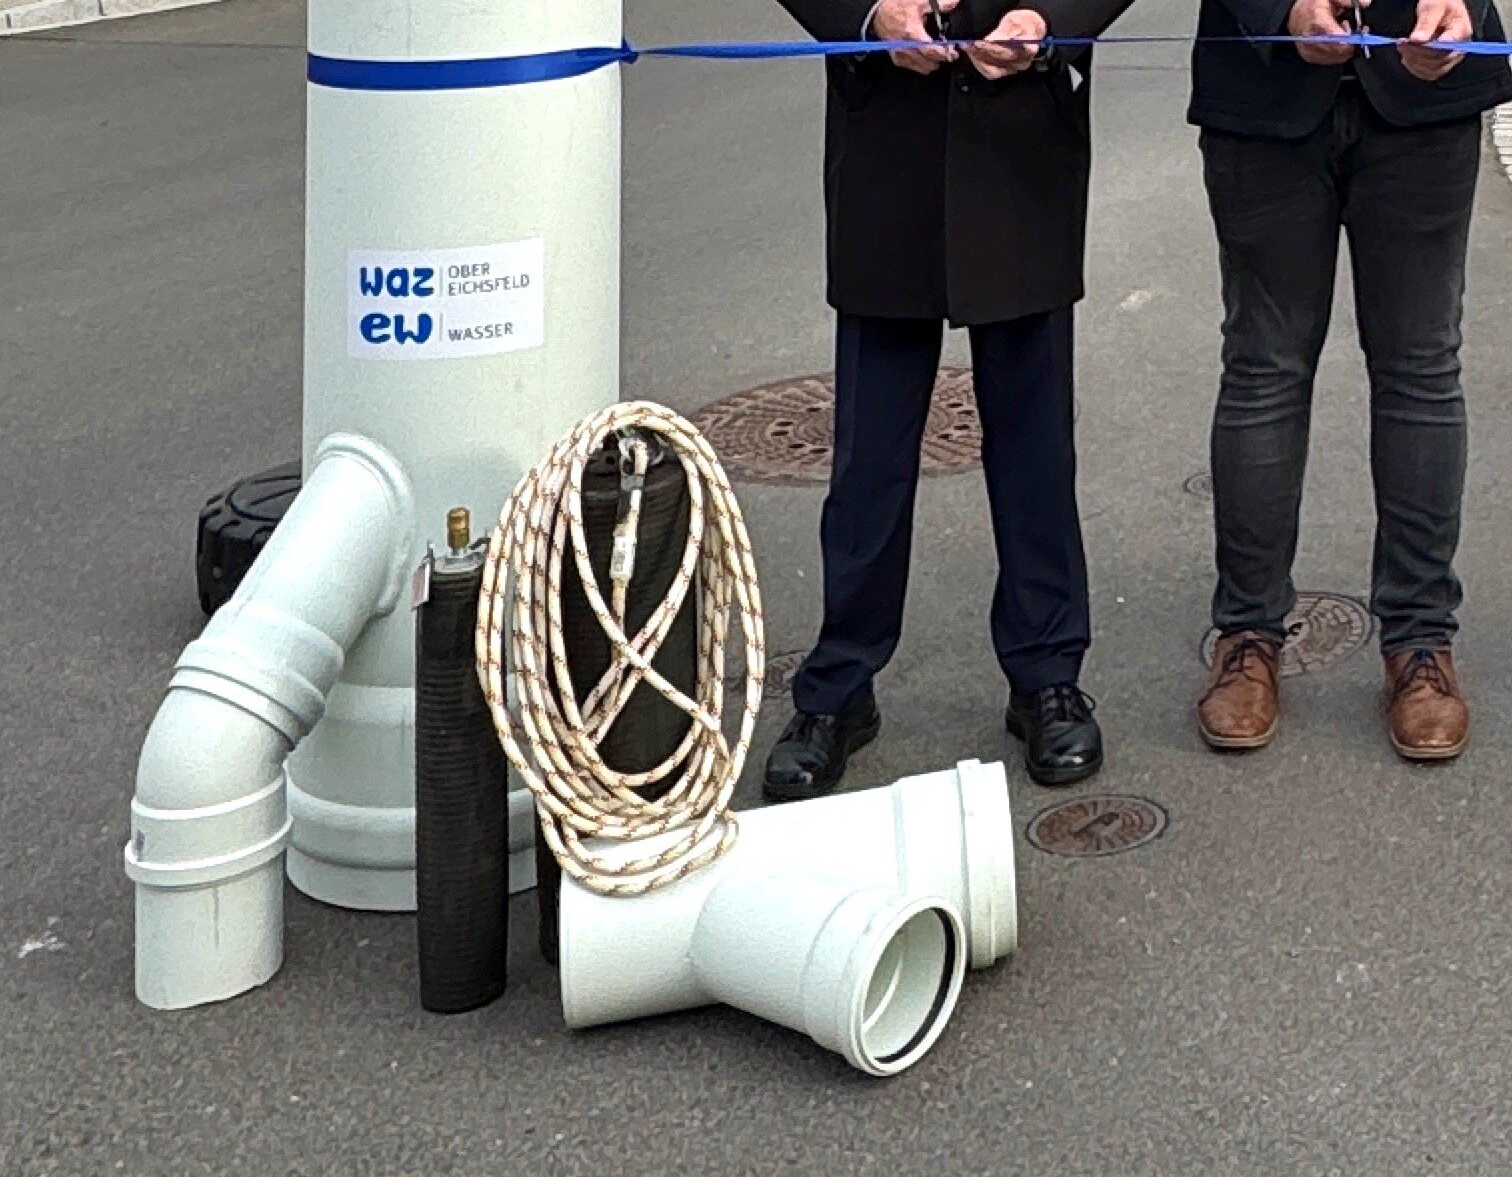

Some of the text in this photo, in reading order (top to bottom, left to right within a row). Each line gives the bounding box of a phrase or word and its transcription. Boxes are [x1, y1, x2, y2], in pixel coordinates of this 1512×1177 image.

[359, 266, 435, 297] waz
[448, 262, 490, 279] OBER
[448, 274, 530, 297] EICHSFELD
[359, 312, 433, 344] ew
[448, 322, 513, 342] WASSER
